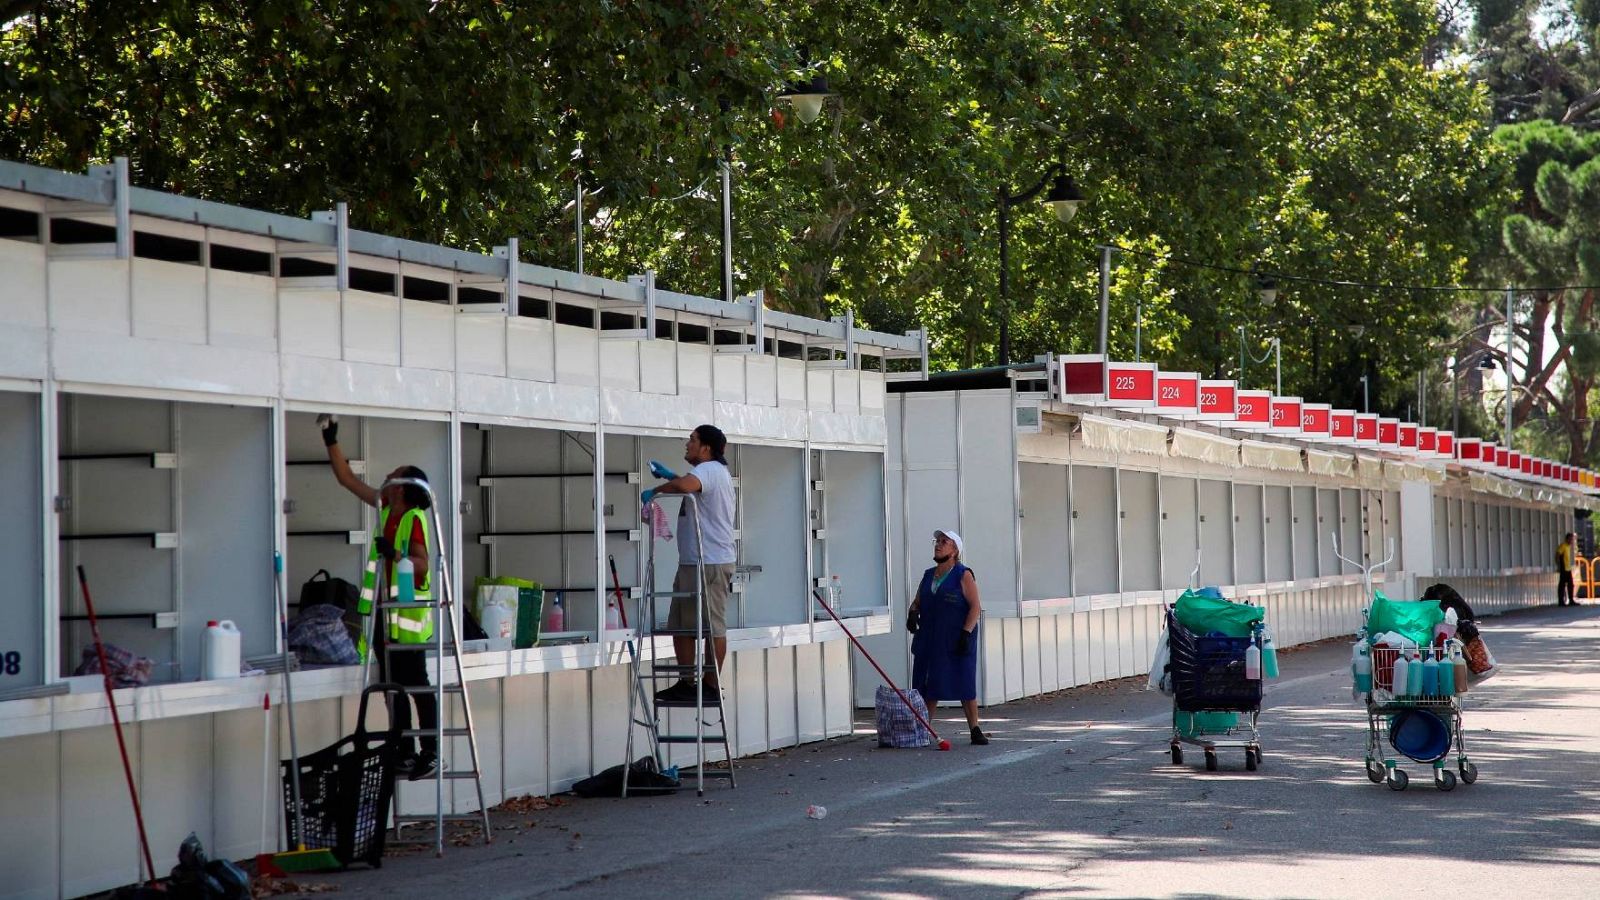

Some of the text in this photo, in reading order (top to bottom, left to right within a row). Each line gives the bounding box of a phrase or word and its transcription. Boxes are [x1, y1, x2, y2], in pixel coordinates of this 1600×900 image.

[1116, 377, 1135, 389] 225
[1162, 387, 1179, 398] 224
[1201, 393, 1217, 405] 223
[1237, 404, 1252, 415] 222
[1303, 415, 1314, 425] 20
[0, 650, 21, 675] 8
